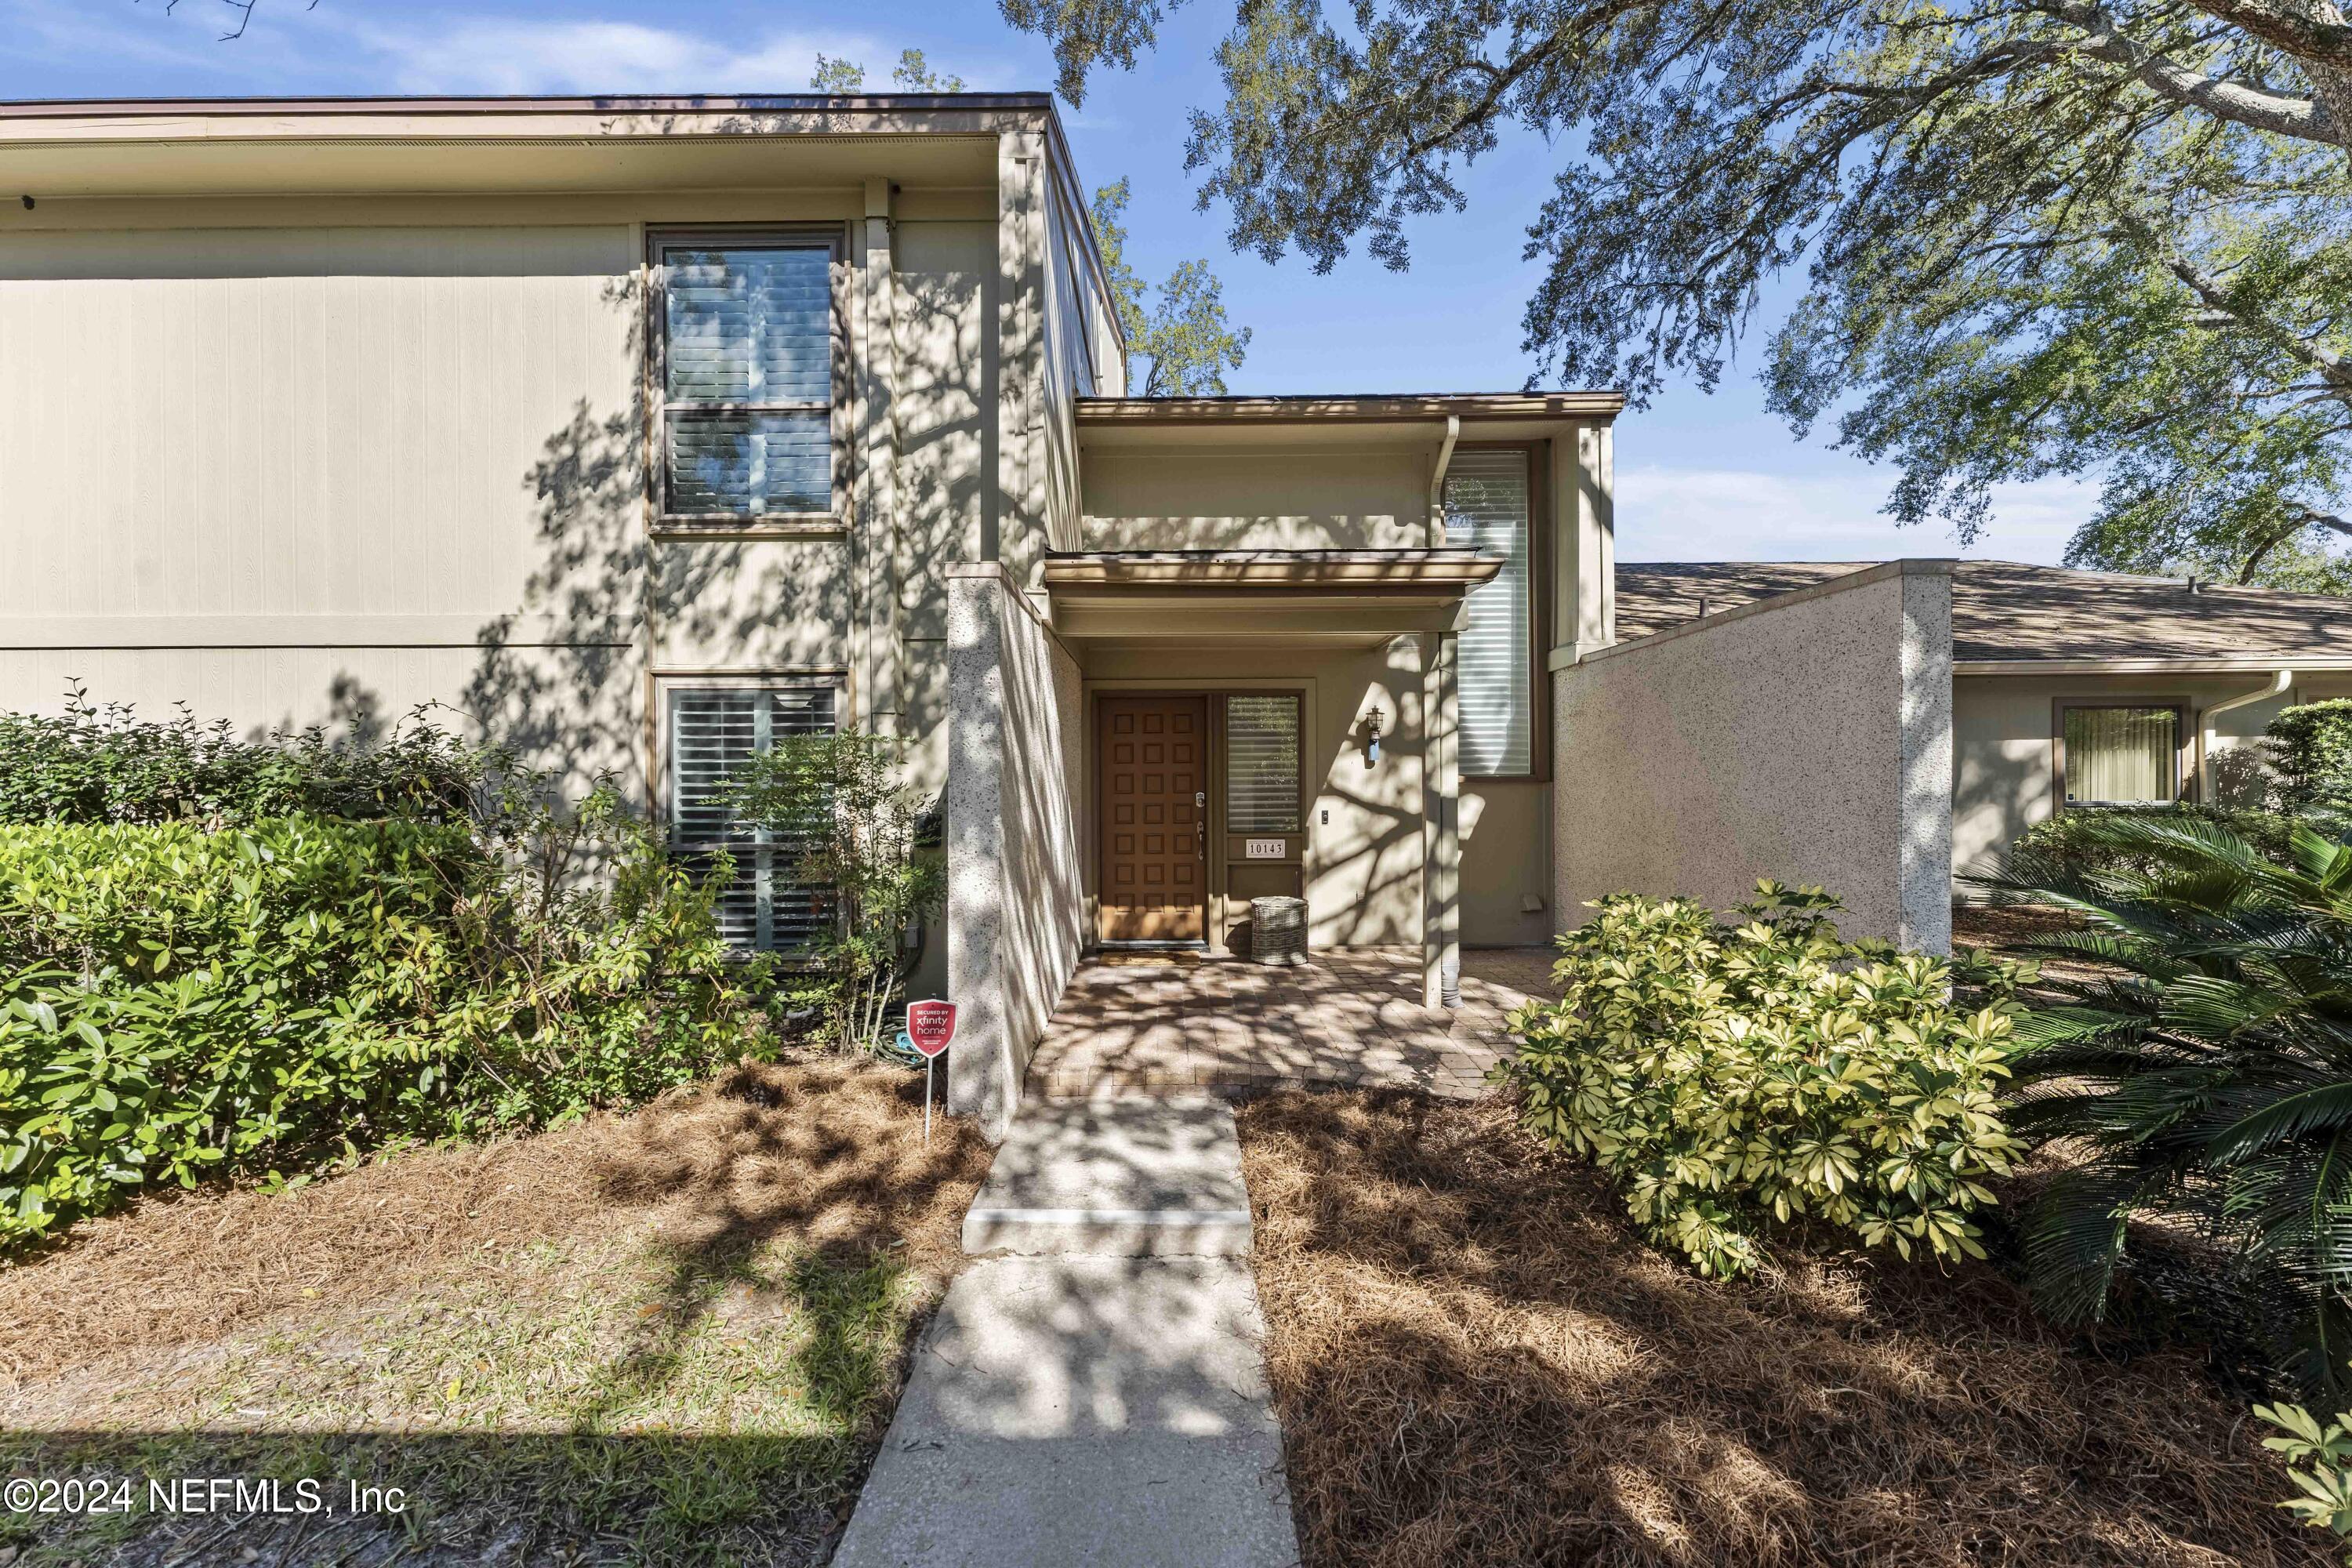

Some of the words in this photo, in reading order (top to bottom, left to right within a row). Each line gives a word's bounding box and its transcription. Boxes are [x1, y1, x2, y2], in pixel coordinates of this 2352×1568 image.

[1250, 844, 1282, 854] 10143
[916, 1015, 948, 1026] xfinity
[916, 1026, 946, 1035] home
